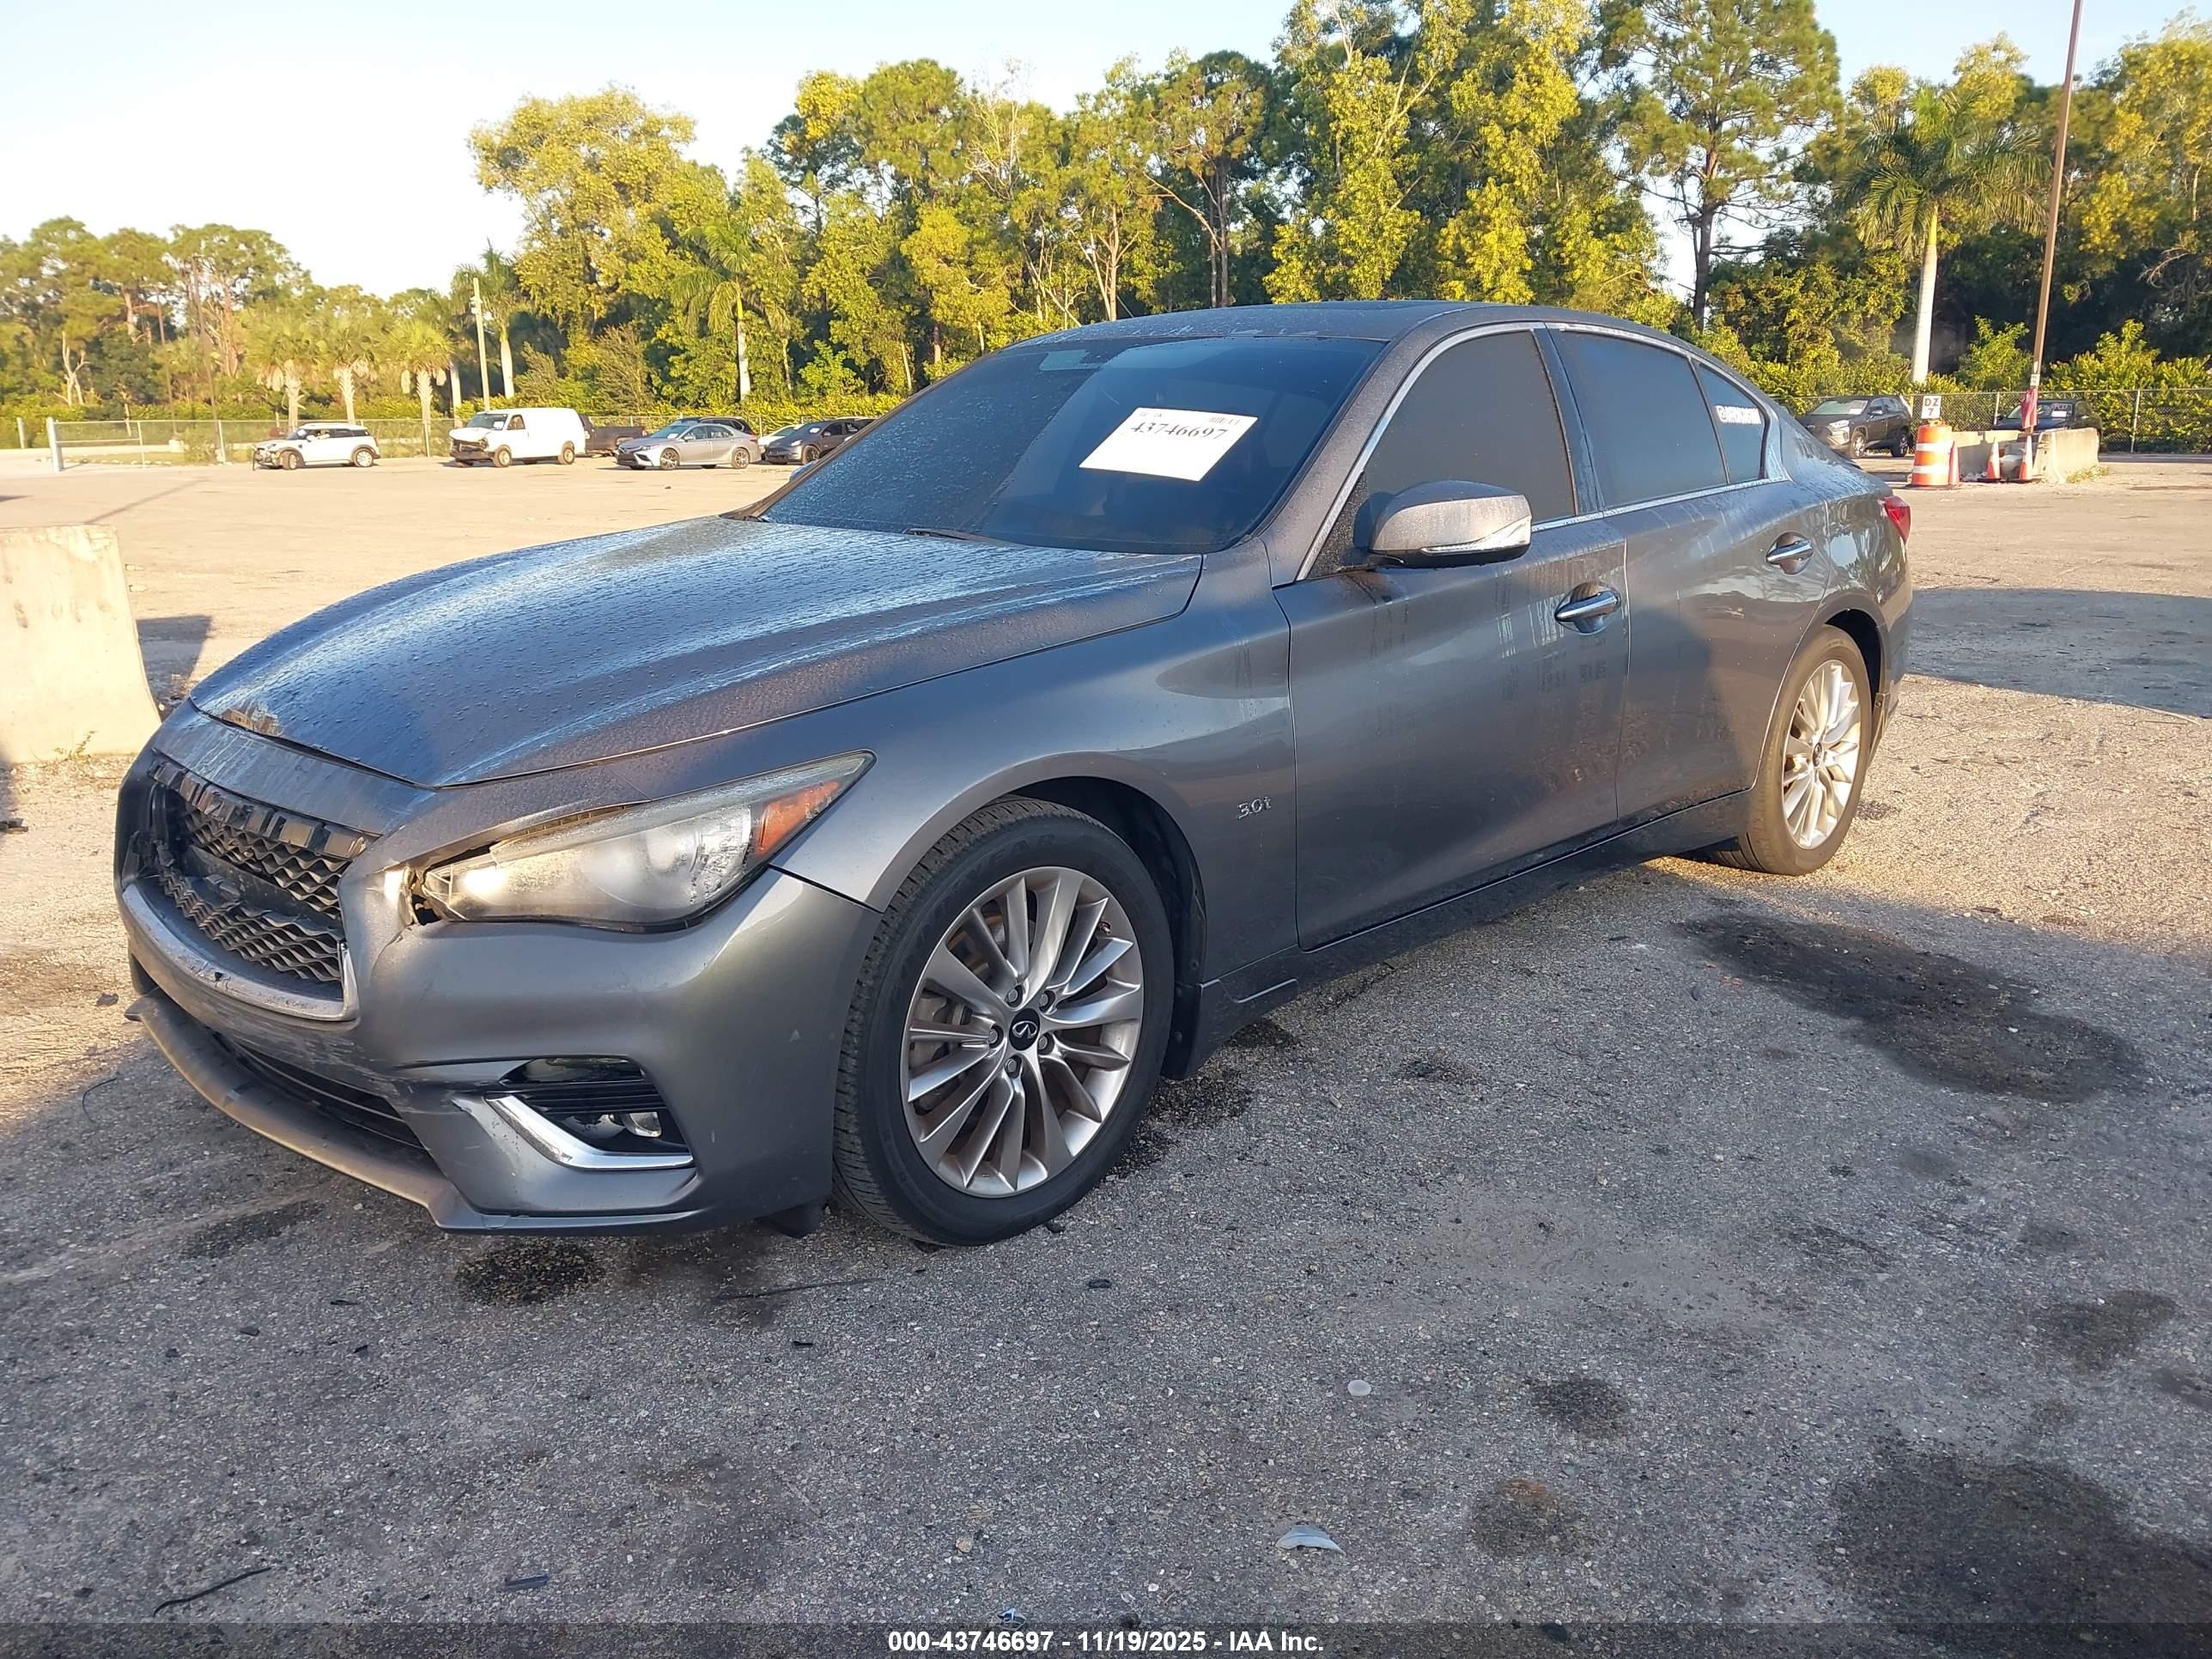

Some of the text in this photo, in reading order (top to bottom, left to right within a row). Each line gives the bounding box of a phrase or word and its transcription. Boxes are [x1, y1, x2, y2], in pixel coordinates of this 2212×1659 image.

[1923, 398, 1940, 406] DZ
[1927, 407, 1935, 416] 7
[1130, 422, 1230, 440] 43746697
